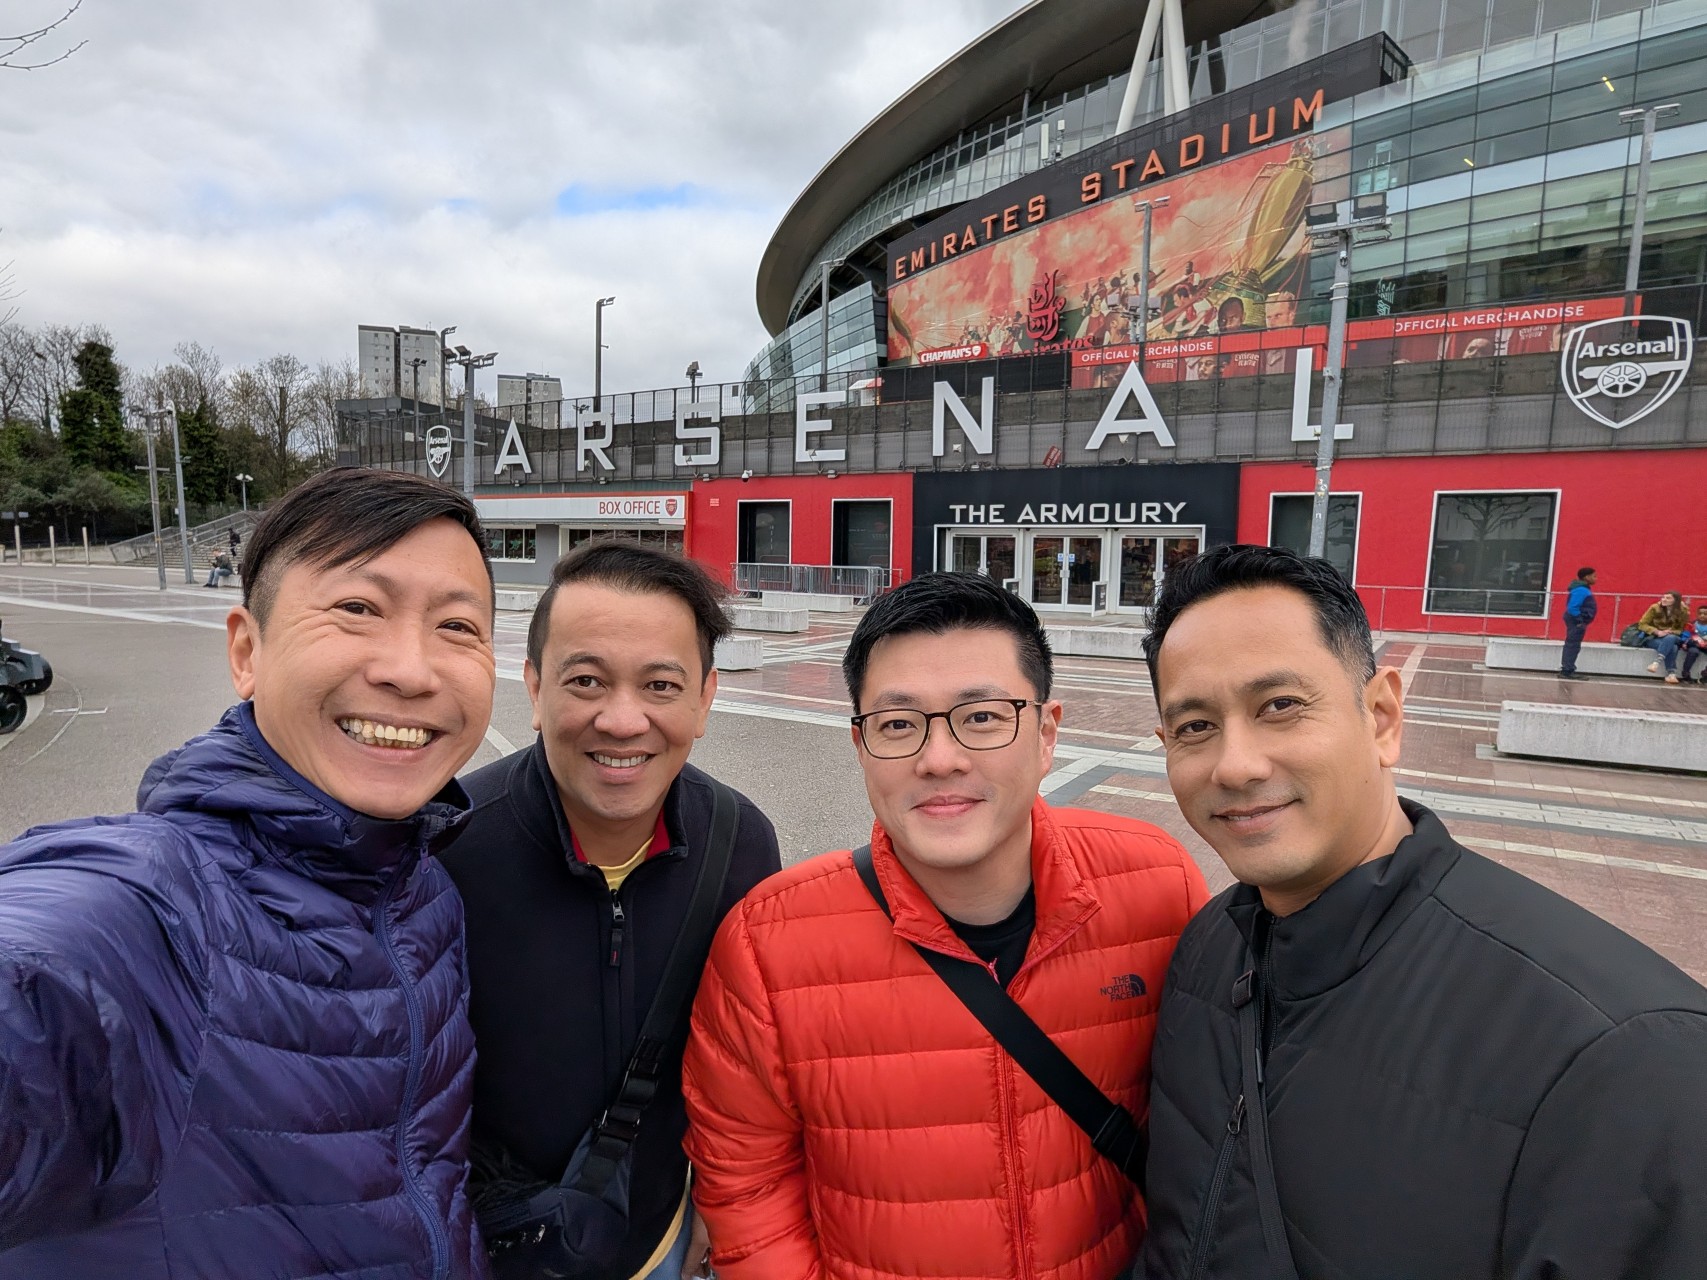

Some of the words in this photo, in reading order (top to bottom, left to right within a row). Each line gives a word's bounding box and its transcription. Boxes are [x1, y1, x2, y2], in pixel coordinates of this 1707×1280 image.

[895, 195, 1046, 280] EMIRATES
[1081, 88, 1325, 203] STADIUM
[1393, 319, 1459, 333] OFFICIAL
[1463, 305, 1585, 326] MERCHANDISE
[920, 347, 972, 363] CHAPMAN'S
[1578, 335, 1674, 359] Arsenal
[1081, 351, 1130, 362] OFFICIAL
[494, 347, 1354, 475] ARSENAL
[599, 501, 621, 515] BOX
[623, 500, 661, 515] OFFICE
[949, 504, 1005, 523] THE
[1017, 502, 1187, 523] ARMOURY
[1112, 974, 1130, 985] THE
[1100, 983, 1131, 996] NORTH
[1110, 992, 1133, 1002] FACE
